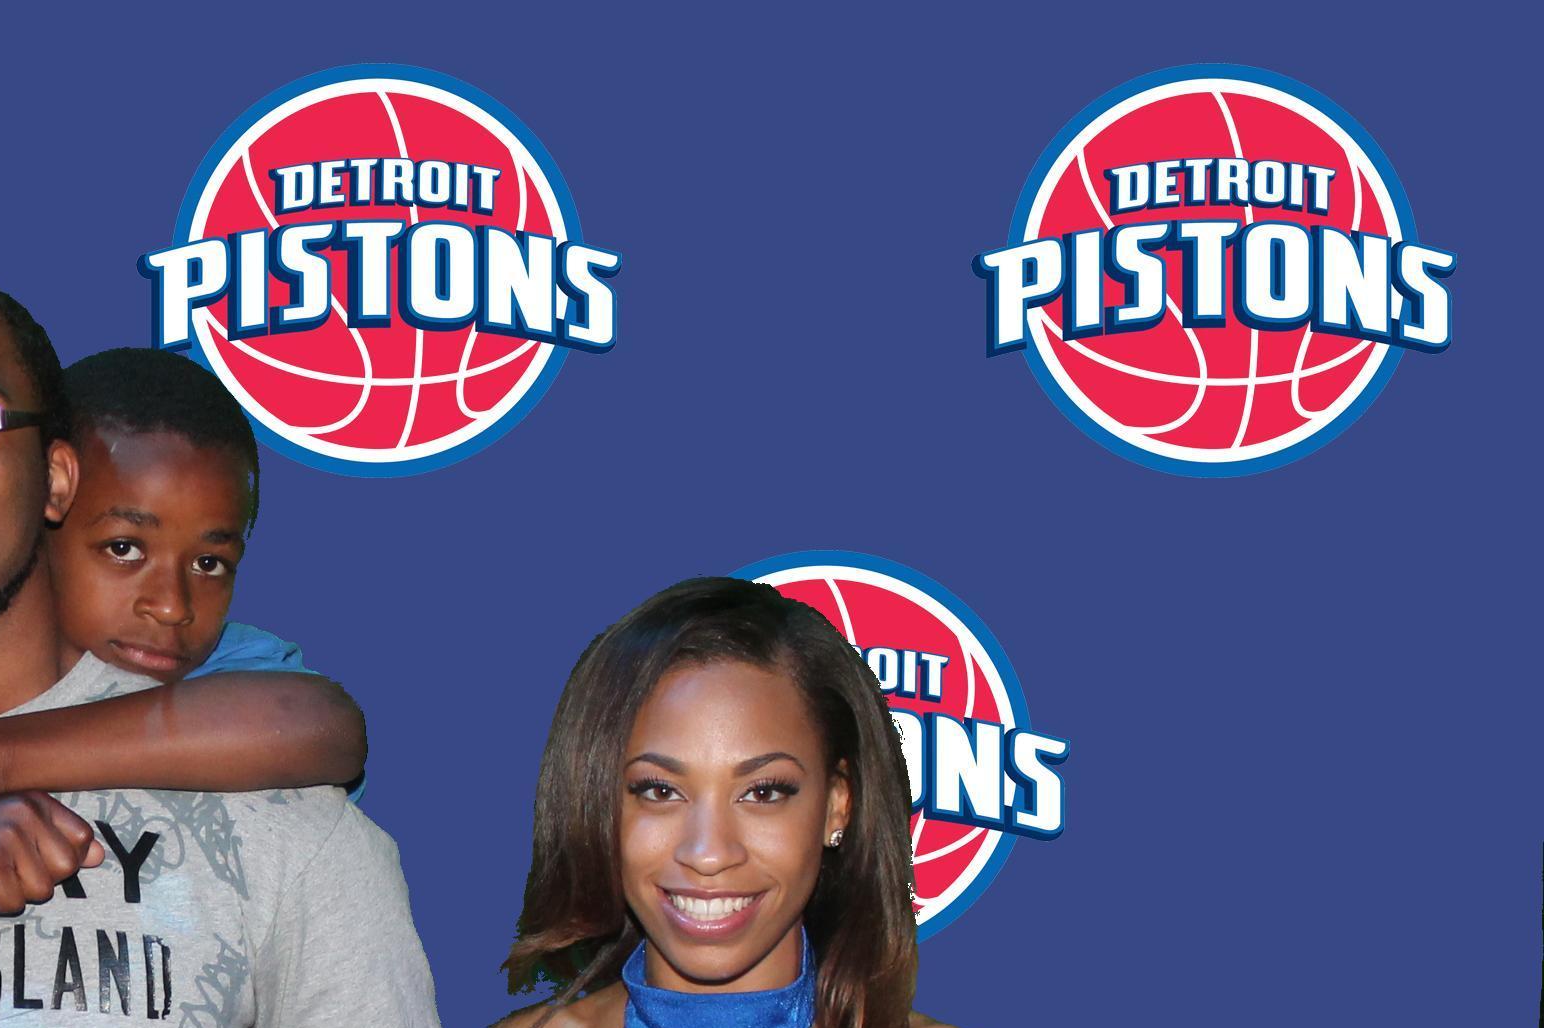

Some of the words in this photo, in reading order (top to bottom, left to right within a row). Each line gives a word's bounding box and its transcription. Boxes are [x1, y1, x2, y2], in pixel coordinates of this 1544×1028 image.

[271, 157, 501, 214] DETROIT
[1106, 157, 1336, 214] DETROIT
[138, 219, 621, 356] PISTONS
[973, 219, 1456, 356] PISTONS
